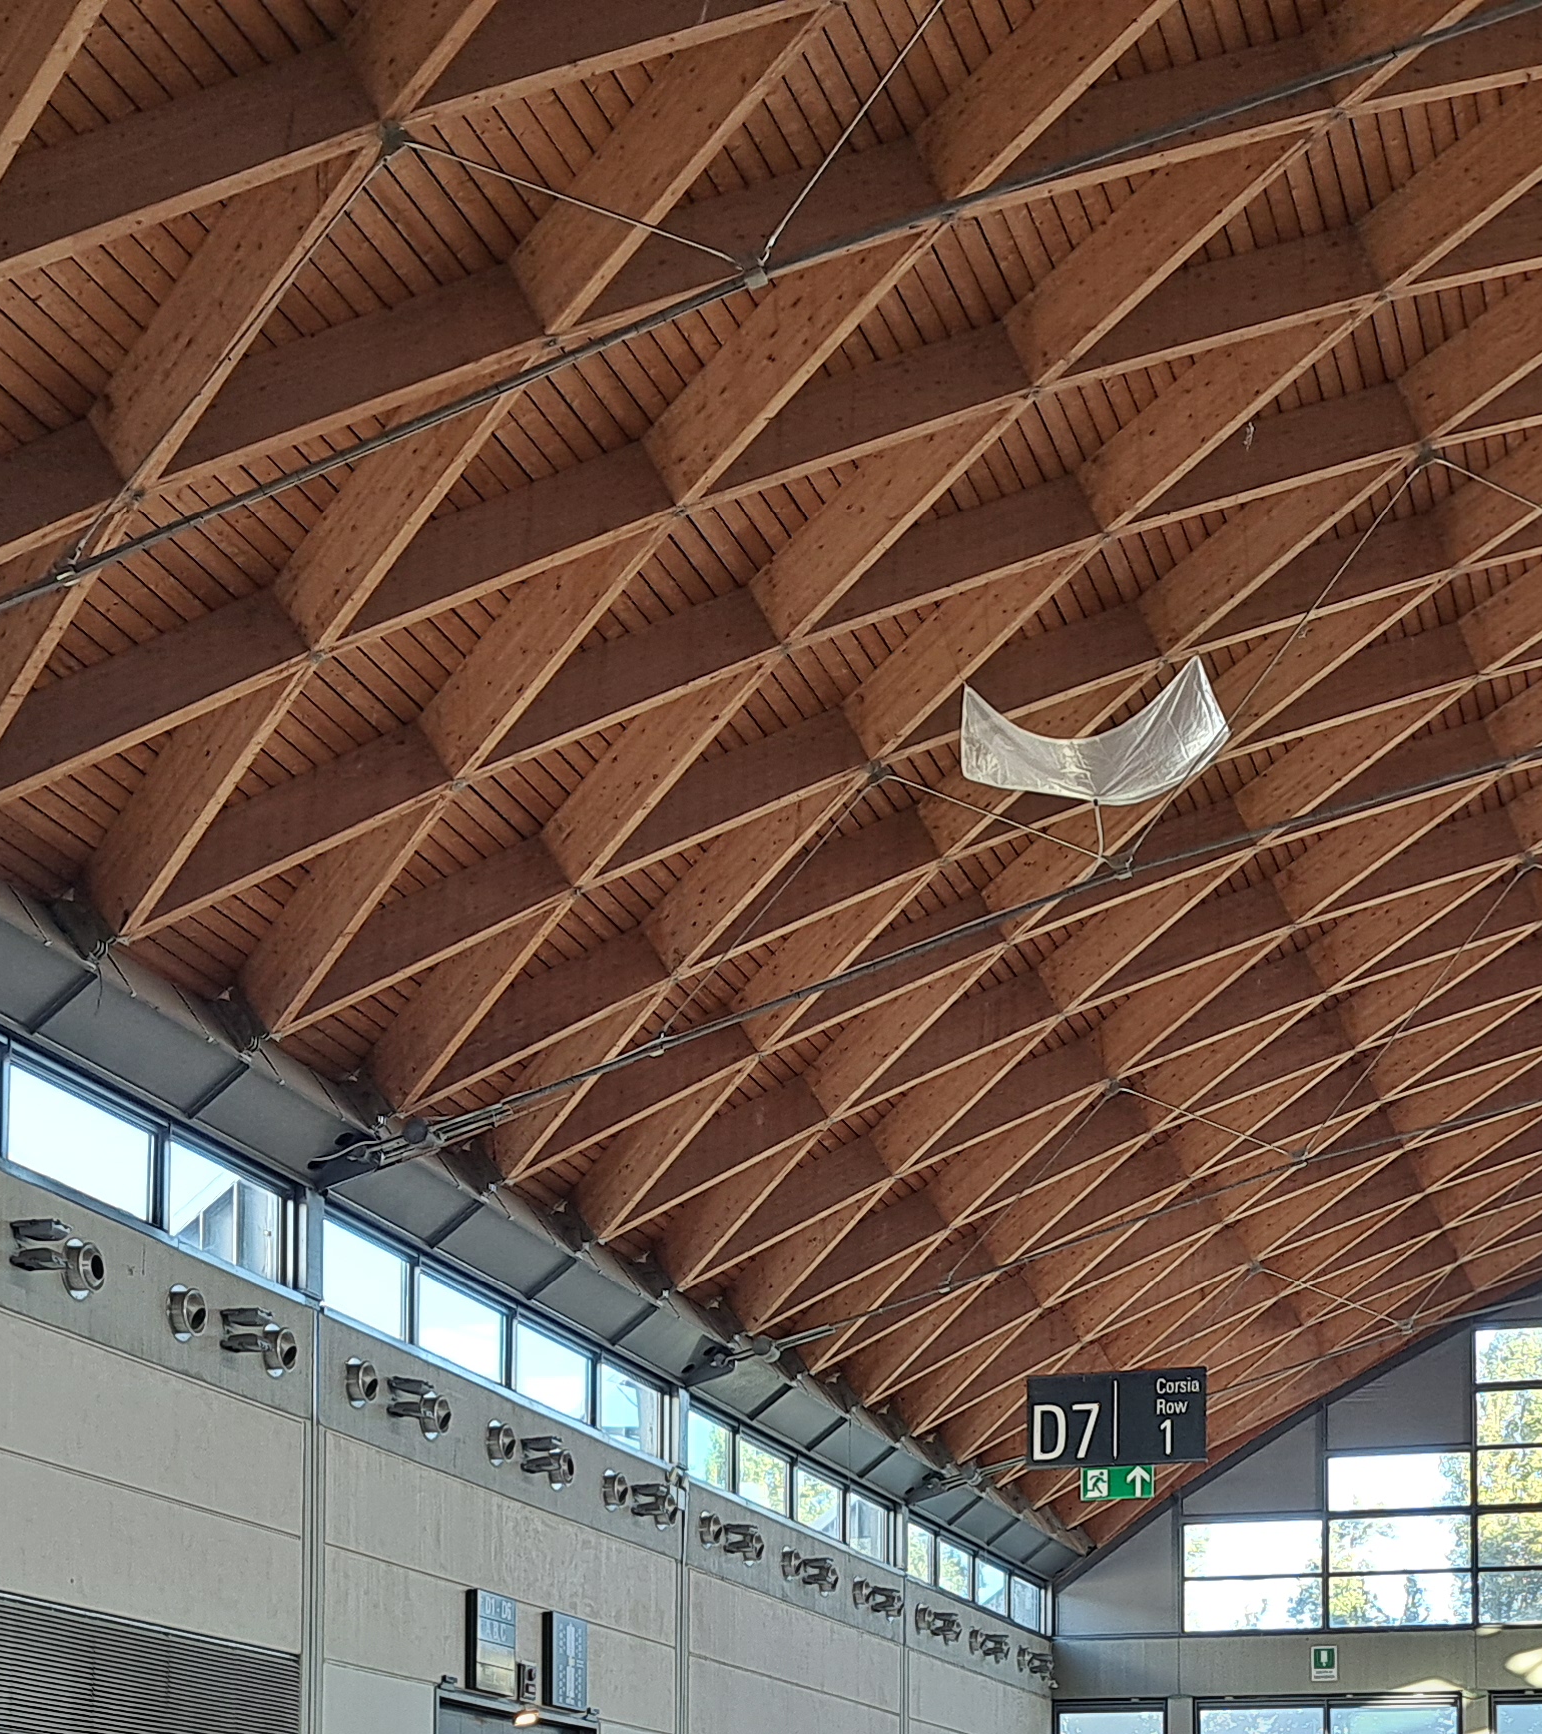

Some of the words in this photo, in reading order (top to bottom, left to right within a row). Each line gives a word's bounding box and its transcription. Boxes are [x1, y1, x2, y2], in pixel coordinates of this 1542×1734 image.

[1156, 1376, 1200, 1395] Corsia
[1156, 1398, 1189, 1416] Row
[1031, 1402, 1102, 1462] D7
[1159, 1418, 1174, 1456] 1
